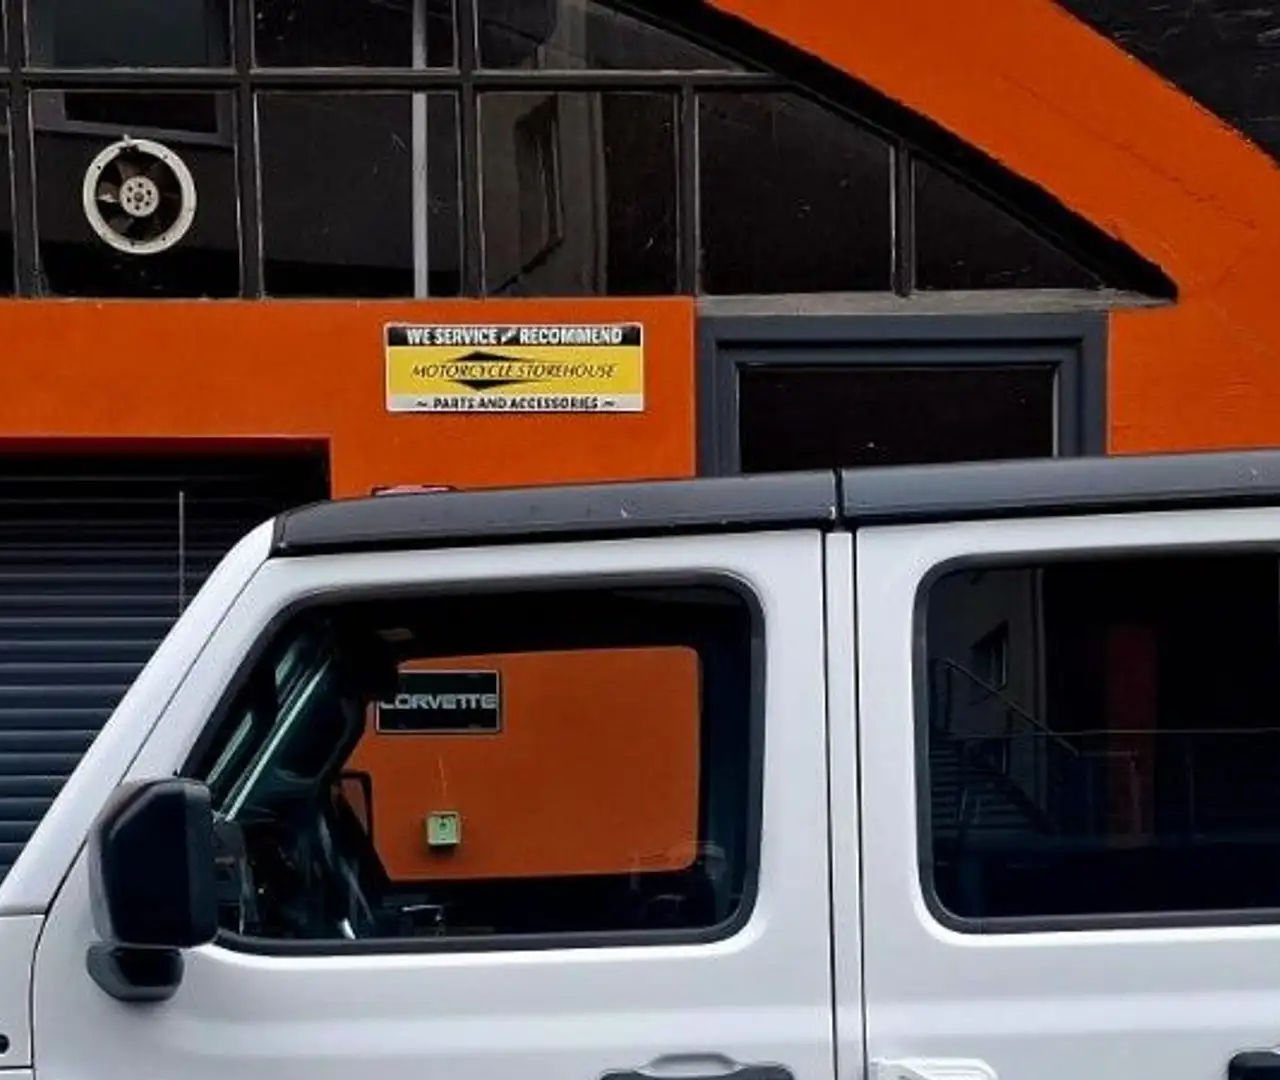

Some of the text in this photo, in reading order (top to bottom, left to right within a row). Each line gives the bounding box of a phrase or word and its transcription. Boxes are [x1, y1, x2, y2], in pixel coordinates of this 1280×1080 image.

[406, 328, 432, 345] WE
[434, 328, 498, 345] SERVICE
[520, 328, 622, 345] RECOMMEND
[410, 363, 619, 378] MOTORCYCLE STOREHOUSE
[433, 396, 599, 409] PARTS AND ACCESSORIES
